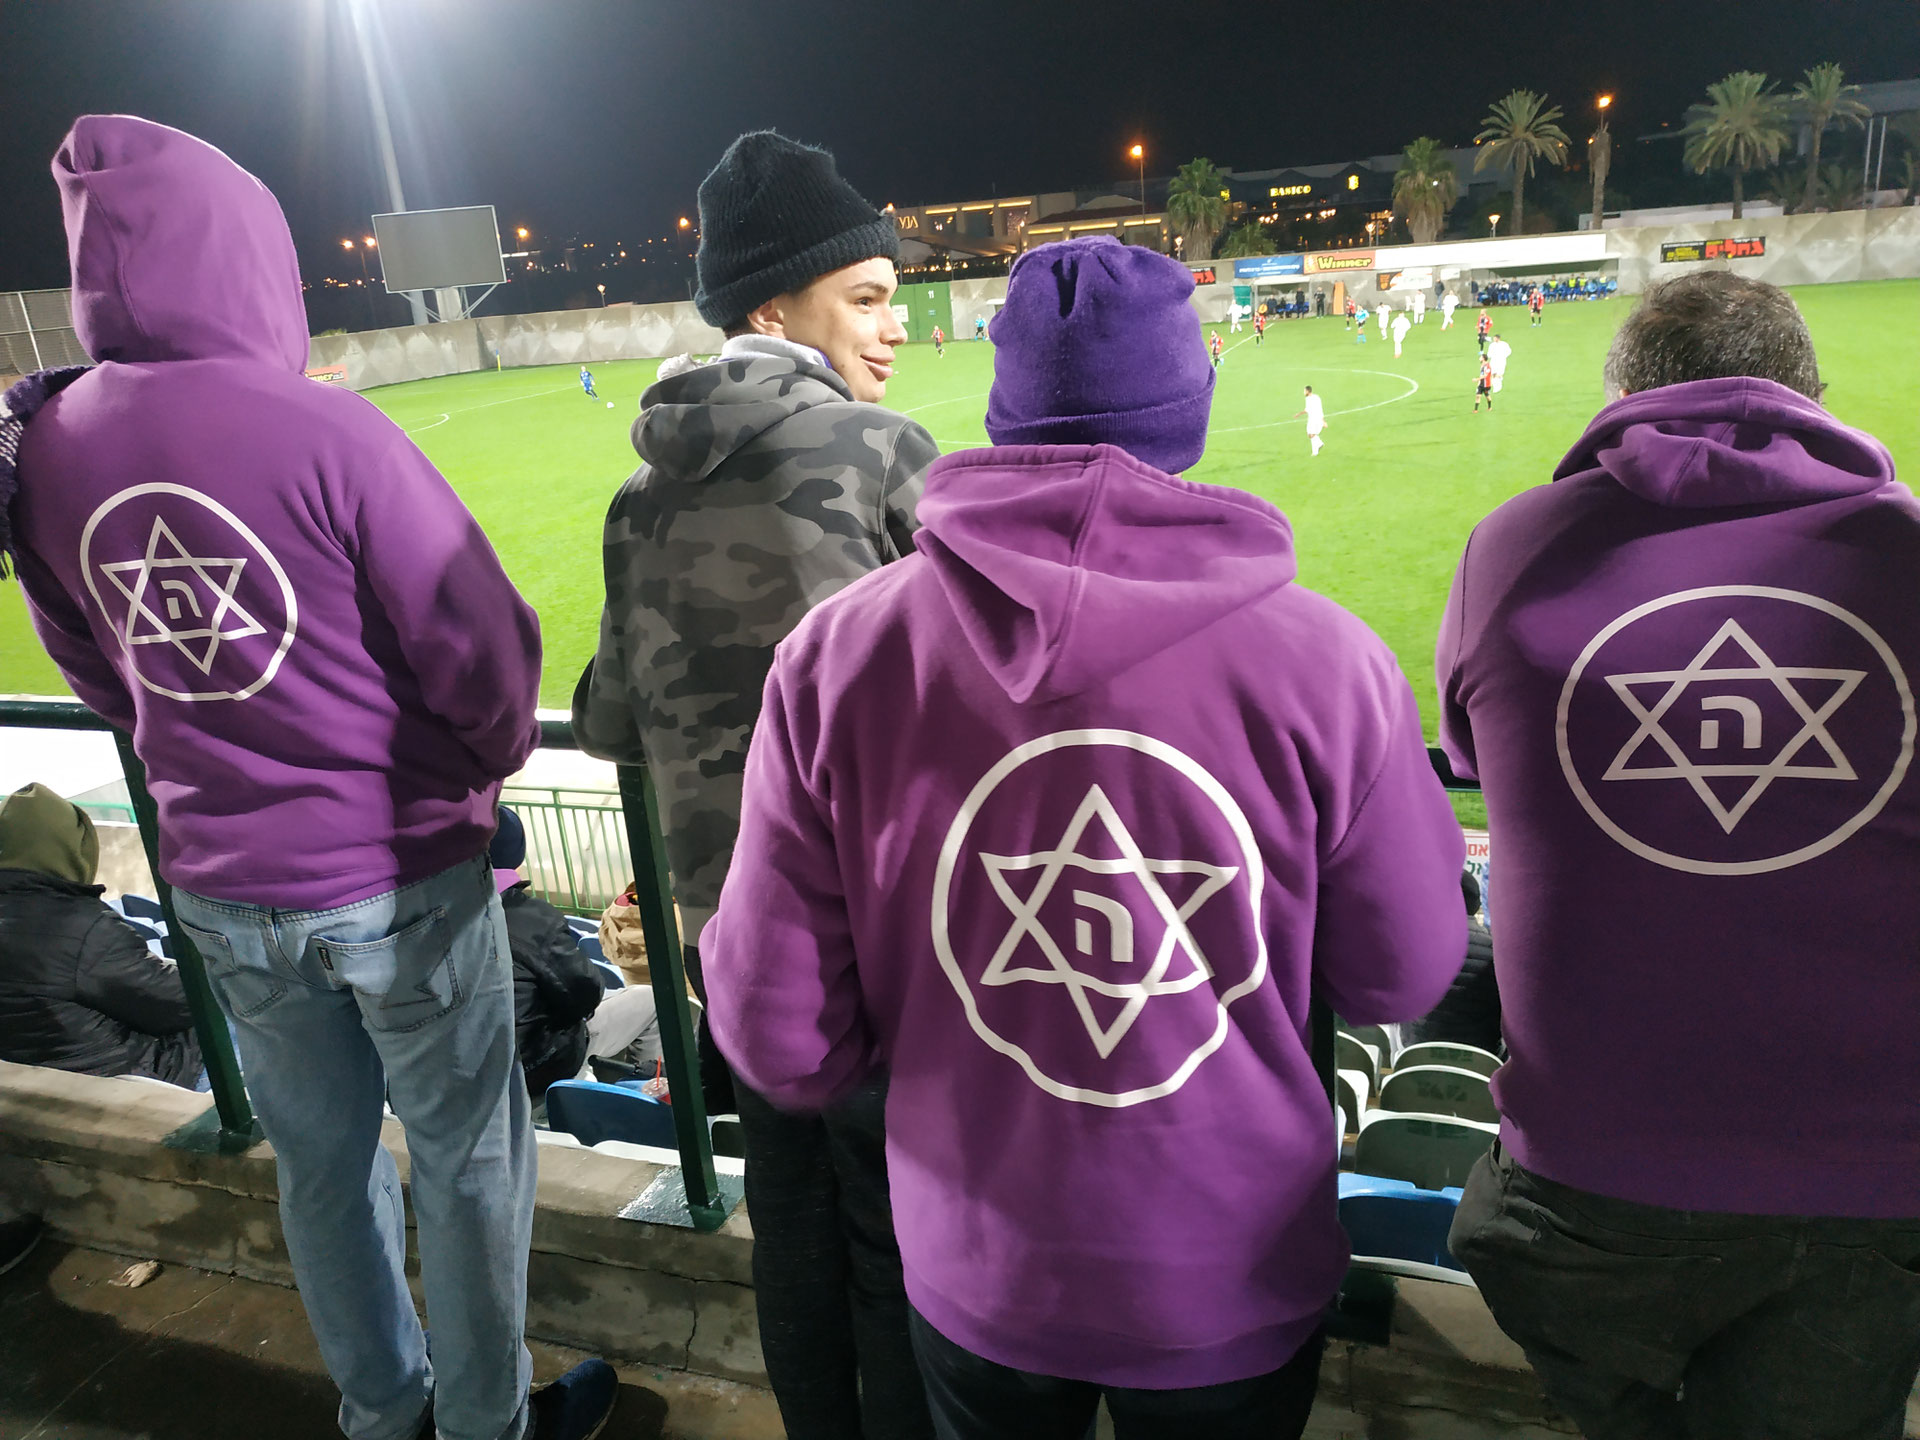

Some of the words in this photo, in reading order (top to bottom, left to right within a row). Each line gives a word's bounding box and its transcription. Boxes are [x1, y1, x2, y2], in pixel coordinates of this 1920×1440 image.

[1270, 184, 1312, 197] BASICO
[1317, 256, 1372, 270] Winner
[160, 579, 203, 620] ה
[1700, 695, 1763, 750] ה
[1072, 889, 1134, 963] ה
